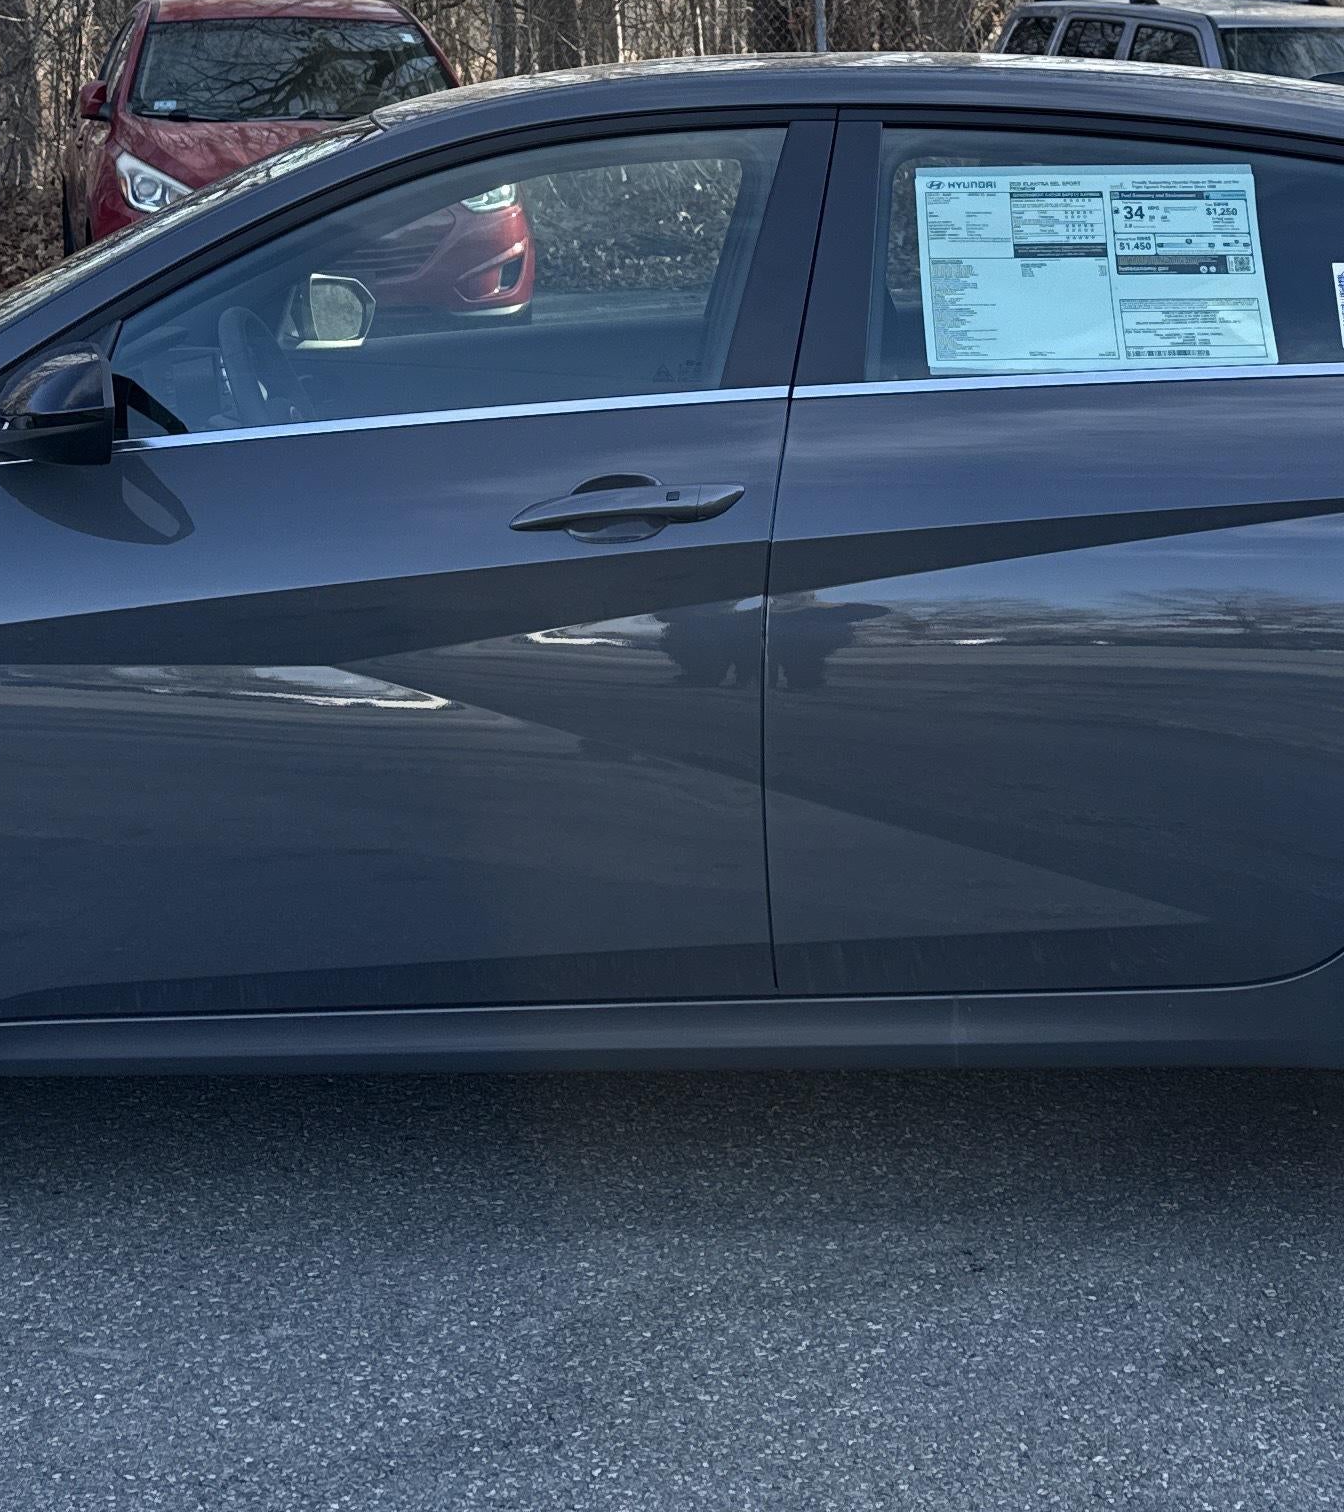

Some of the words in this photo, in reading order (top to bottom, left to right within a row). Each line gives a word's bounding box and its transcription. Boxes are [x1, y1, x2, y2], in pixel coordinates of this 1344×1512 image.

[948, 180, 997, 189] HYUNDAI
[1123, 205, 1145, 220] 34
[1205, 207, 1238, 217] $1,250
[1119, 242, 1152, 250] $1,450
